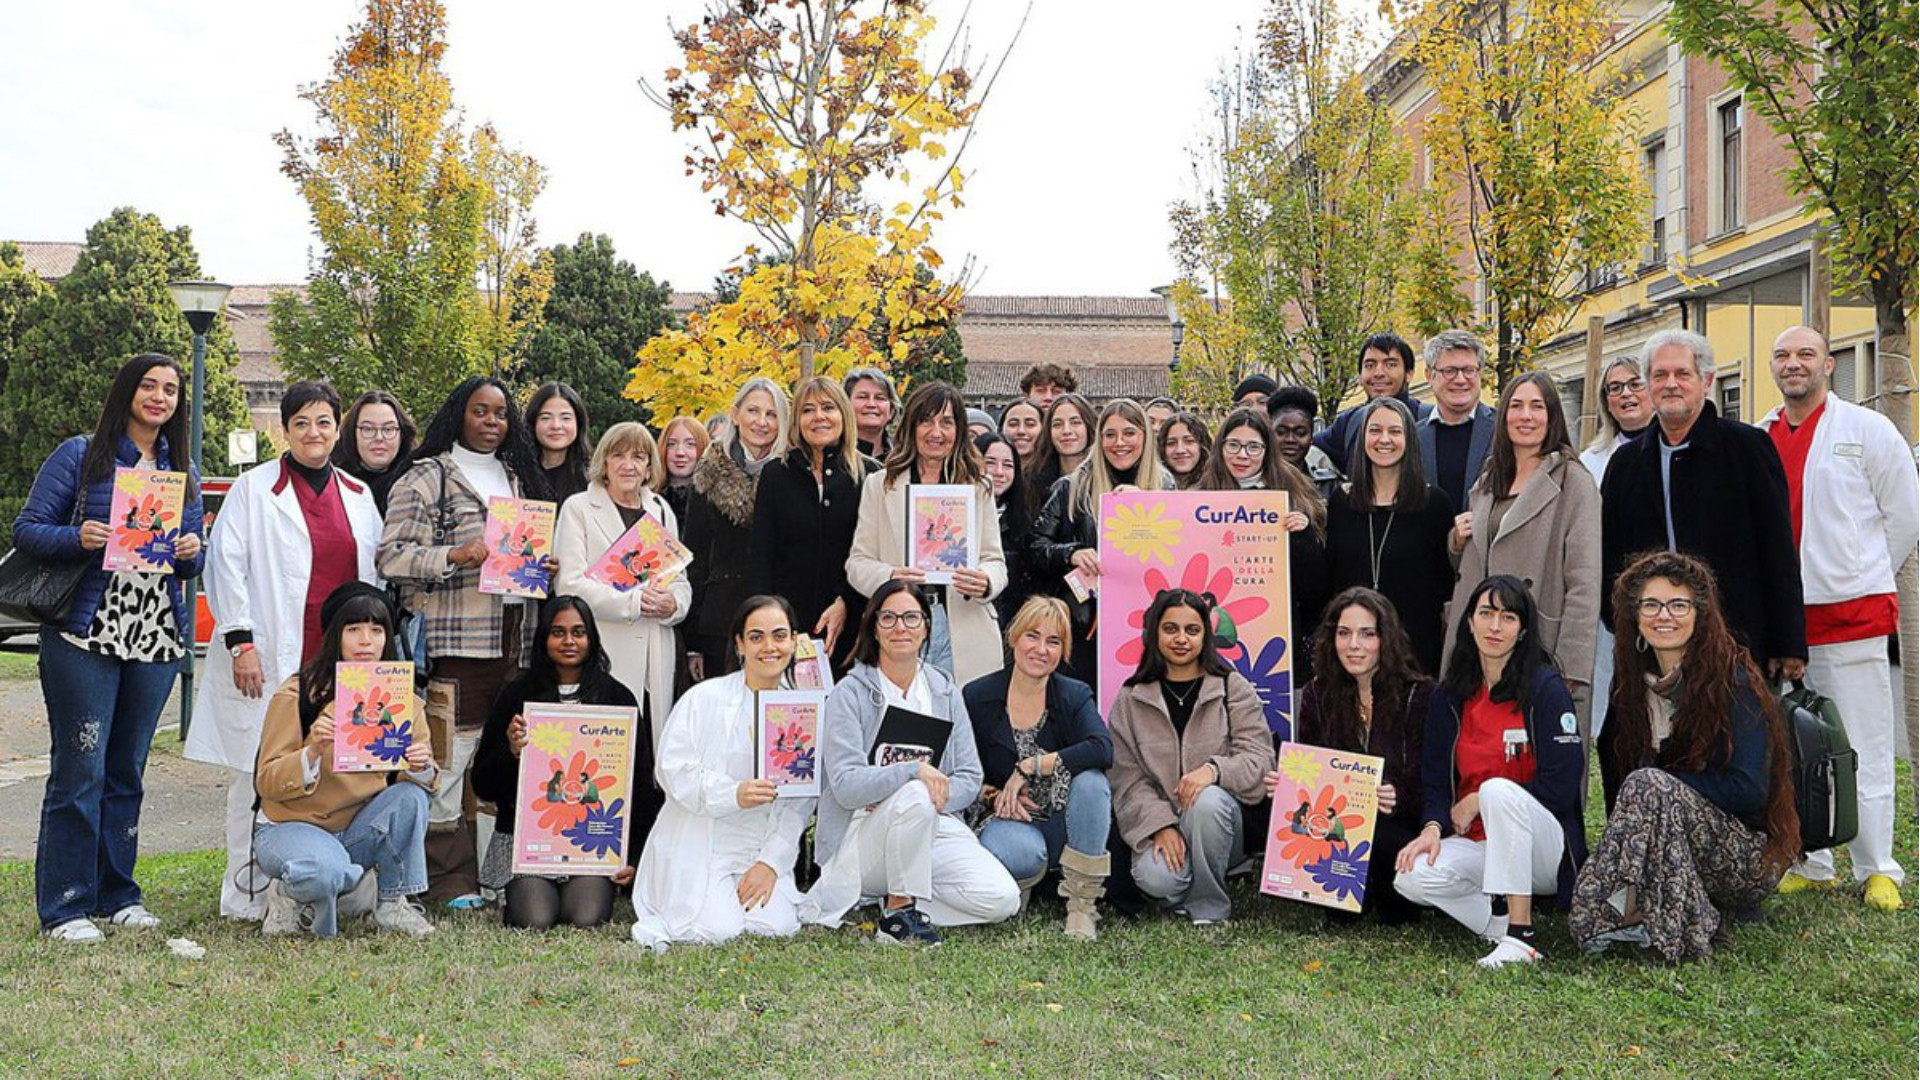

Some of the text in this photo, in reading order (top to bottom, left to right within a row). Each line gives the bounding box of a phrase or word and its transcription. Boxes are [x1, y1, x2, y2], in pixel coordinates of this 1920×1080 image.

[1195, 505, 1279, 523] CurArte
[1236, 535, 1278, 543] START-UP
[1233, 556, 1274, 564] L'ARTE
[1233, 577, 1265, 585] CURA
[579, 724, 626, 737] CurArte
[1329, 757, 1378, 777] CurArte
